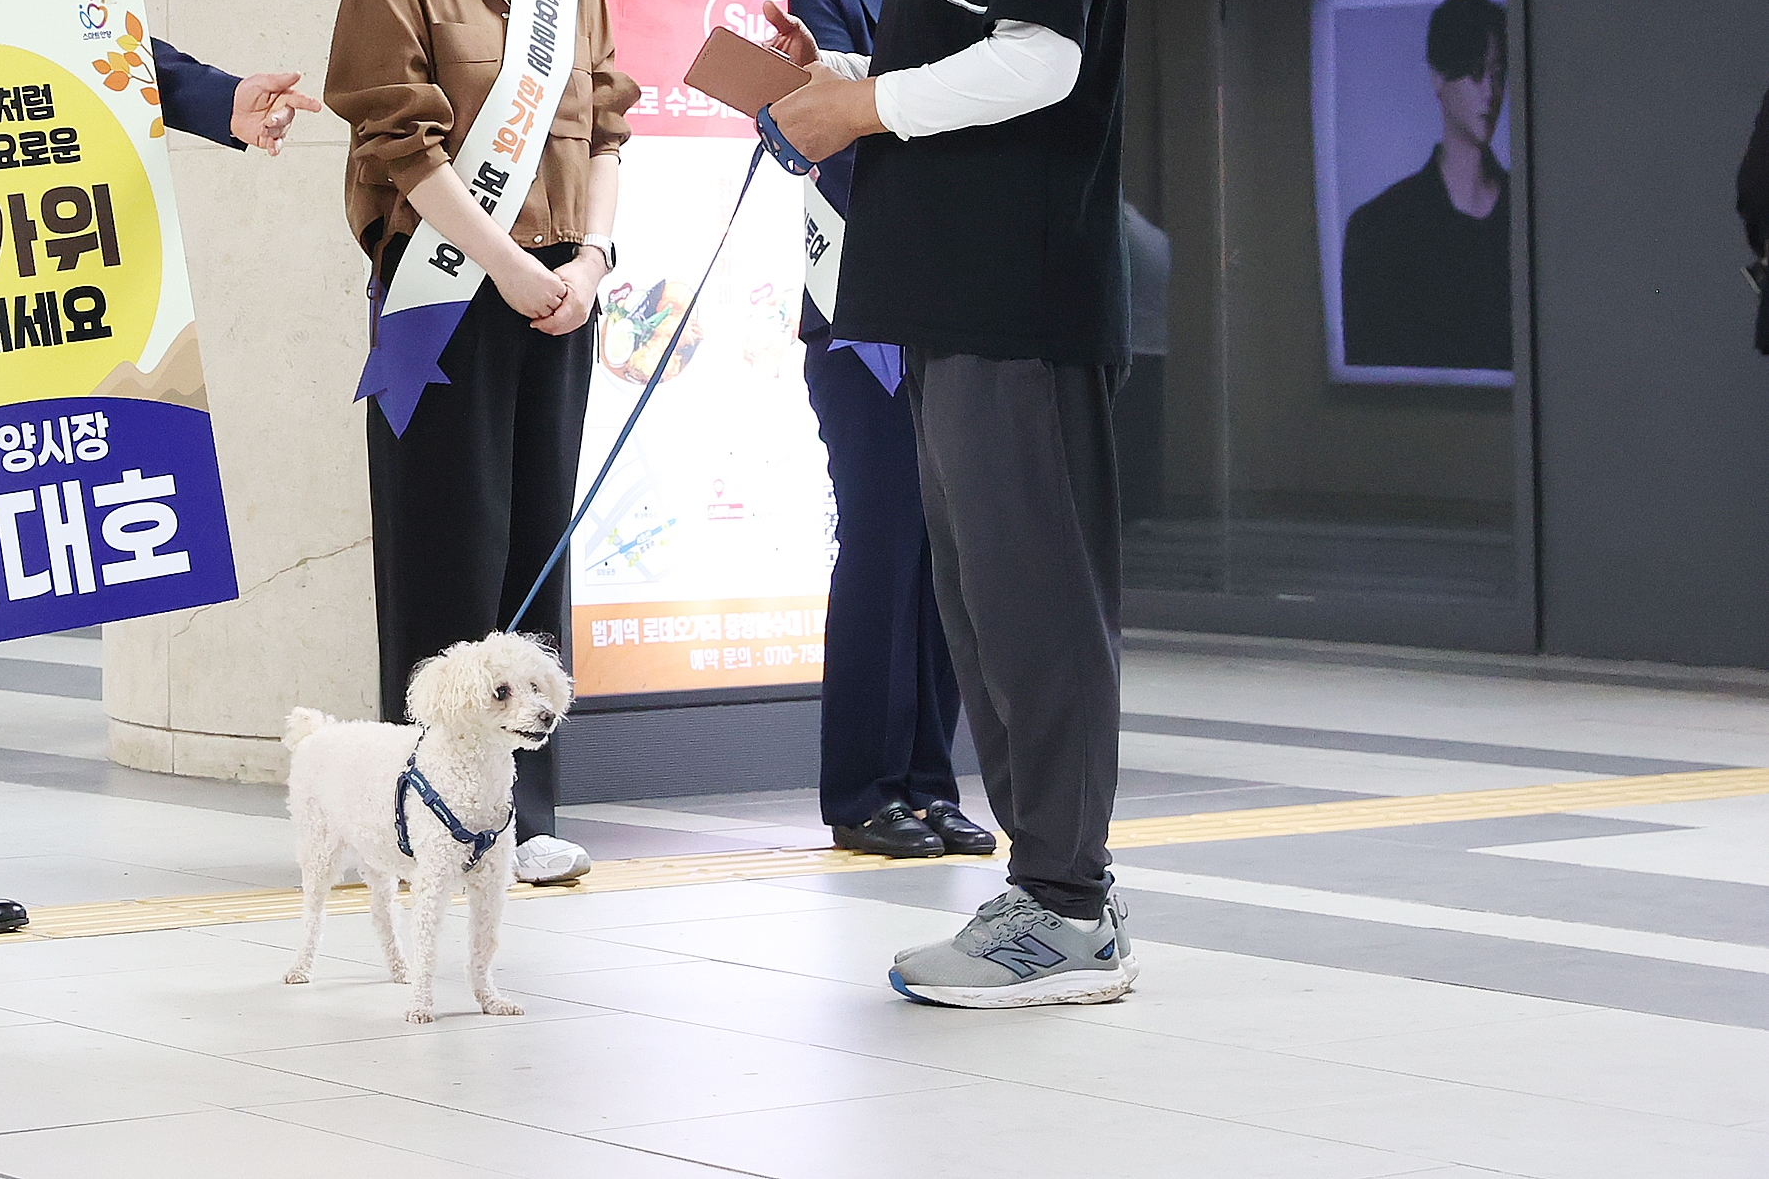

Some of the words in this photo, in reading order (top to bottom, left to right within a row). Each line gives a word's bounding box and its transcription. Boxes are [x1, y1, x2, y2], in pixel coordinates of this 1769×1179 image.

[492, 73, 545, 164] 한가위
[591, 618, 640, 648] 범계역
[690, 648, 720, 671] 예약
[723, 646, 753, 670] 문의
